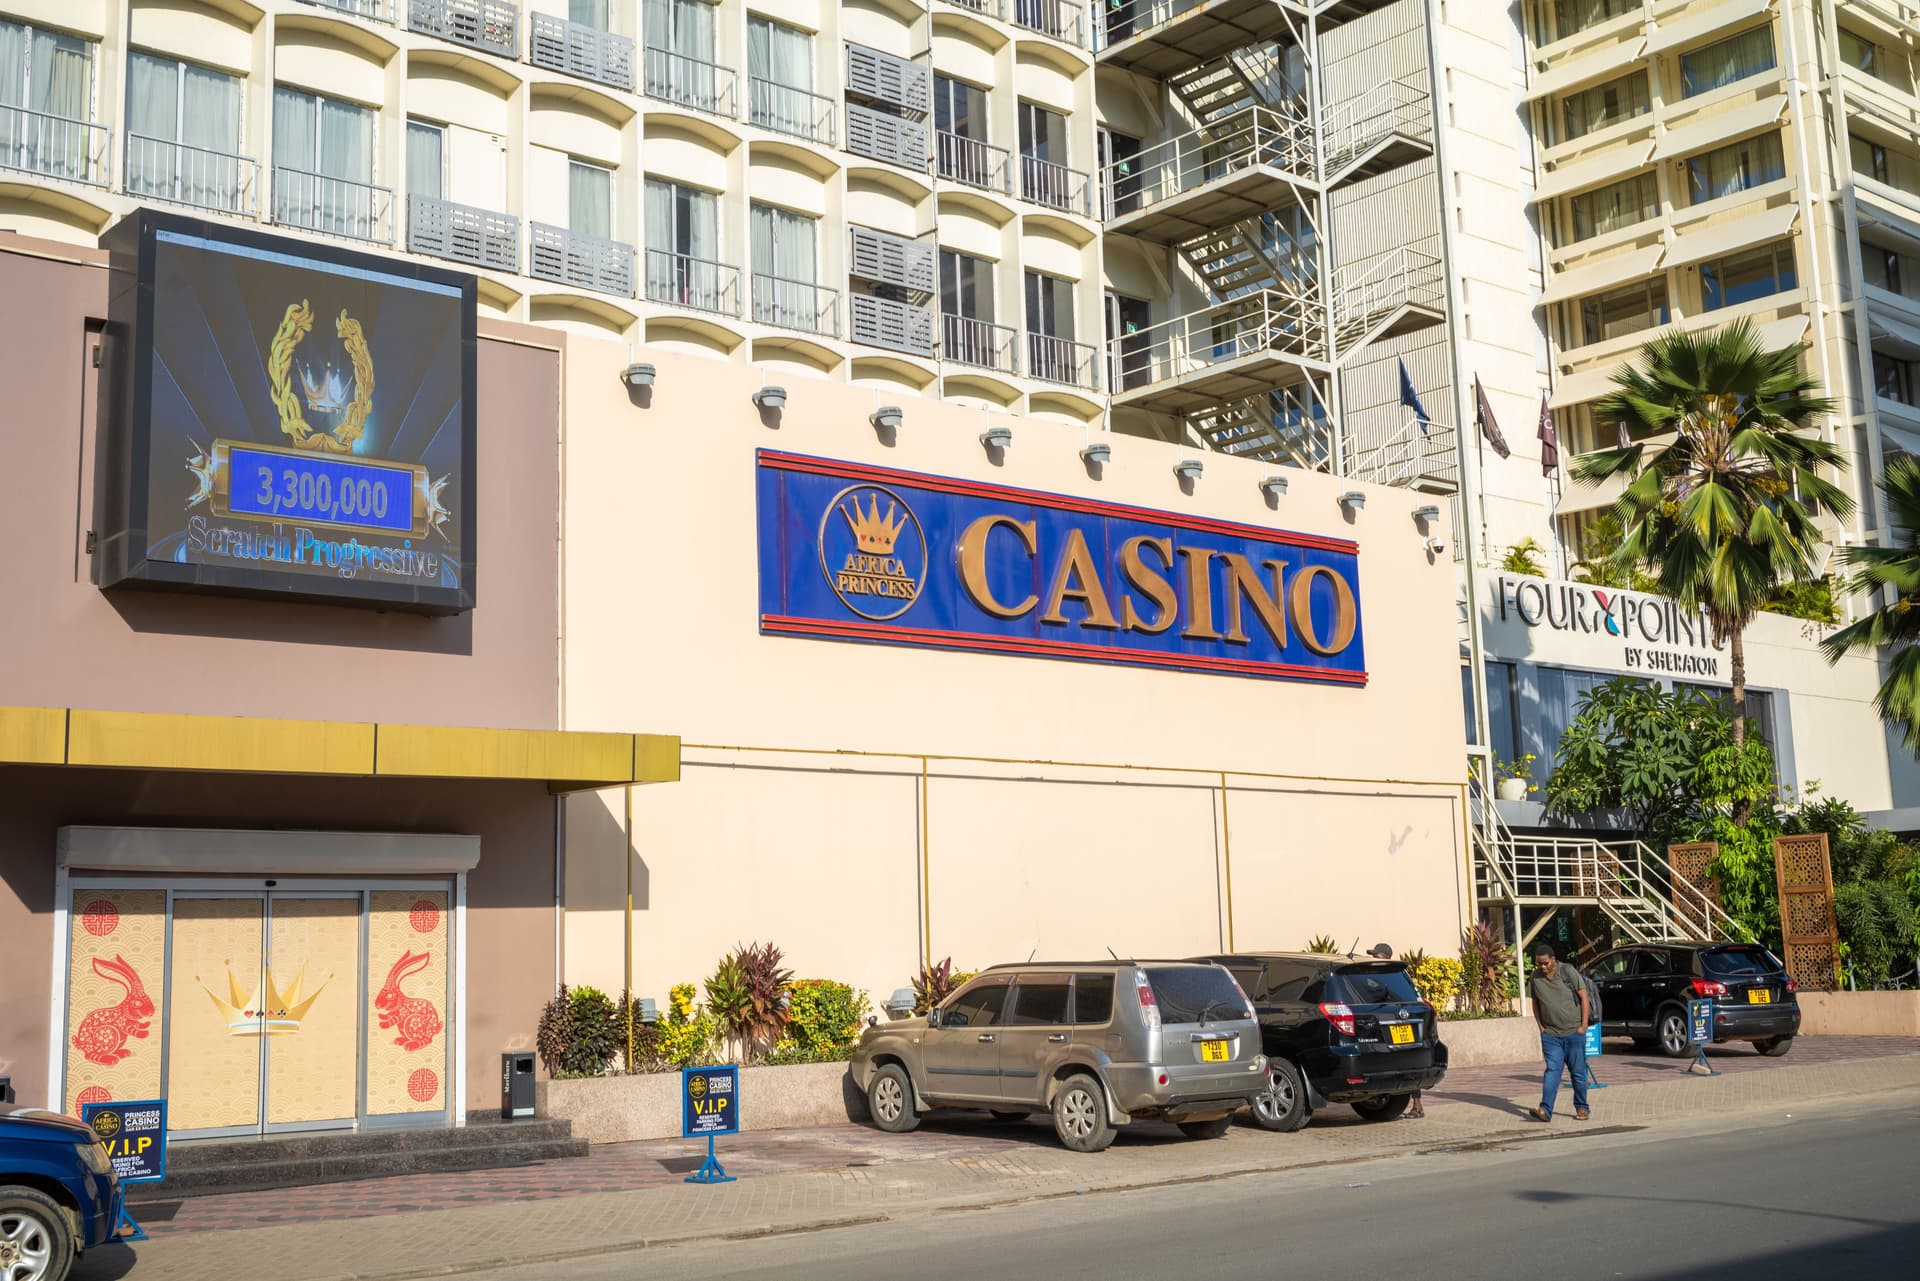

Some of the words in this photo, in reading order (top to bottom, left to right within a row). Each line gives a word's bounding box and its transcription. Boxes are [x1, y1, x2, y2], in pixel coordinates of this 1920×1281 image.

[257, 466, 388, 520] 3,300,000
[187, 515, 292, 563] Scratch
[294, 527, 439, 579] Progressive
[844, 553, 907, 577] AFRICA
[837, 574, 916, 600] PRINCESS
[956, 514, 1358, 658] CASINO
[1499, 576, 1592, 634] FOUR
[1624, 647, 1642, 668] BY
[1646, 650, 1718, 677] SHERATON
[124, 1110, 160, 1119] PRINCESS
[693, 1098, 728, 1115] V.I.P
[95, 1116, 118, 1124] AFRICA
[124, 1116, 160, 1127] CASINO
[101, 1136, 152, 1157] V.I.P
[111, 1156, 141, 1164] ESERVED
